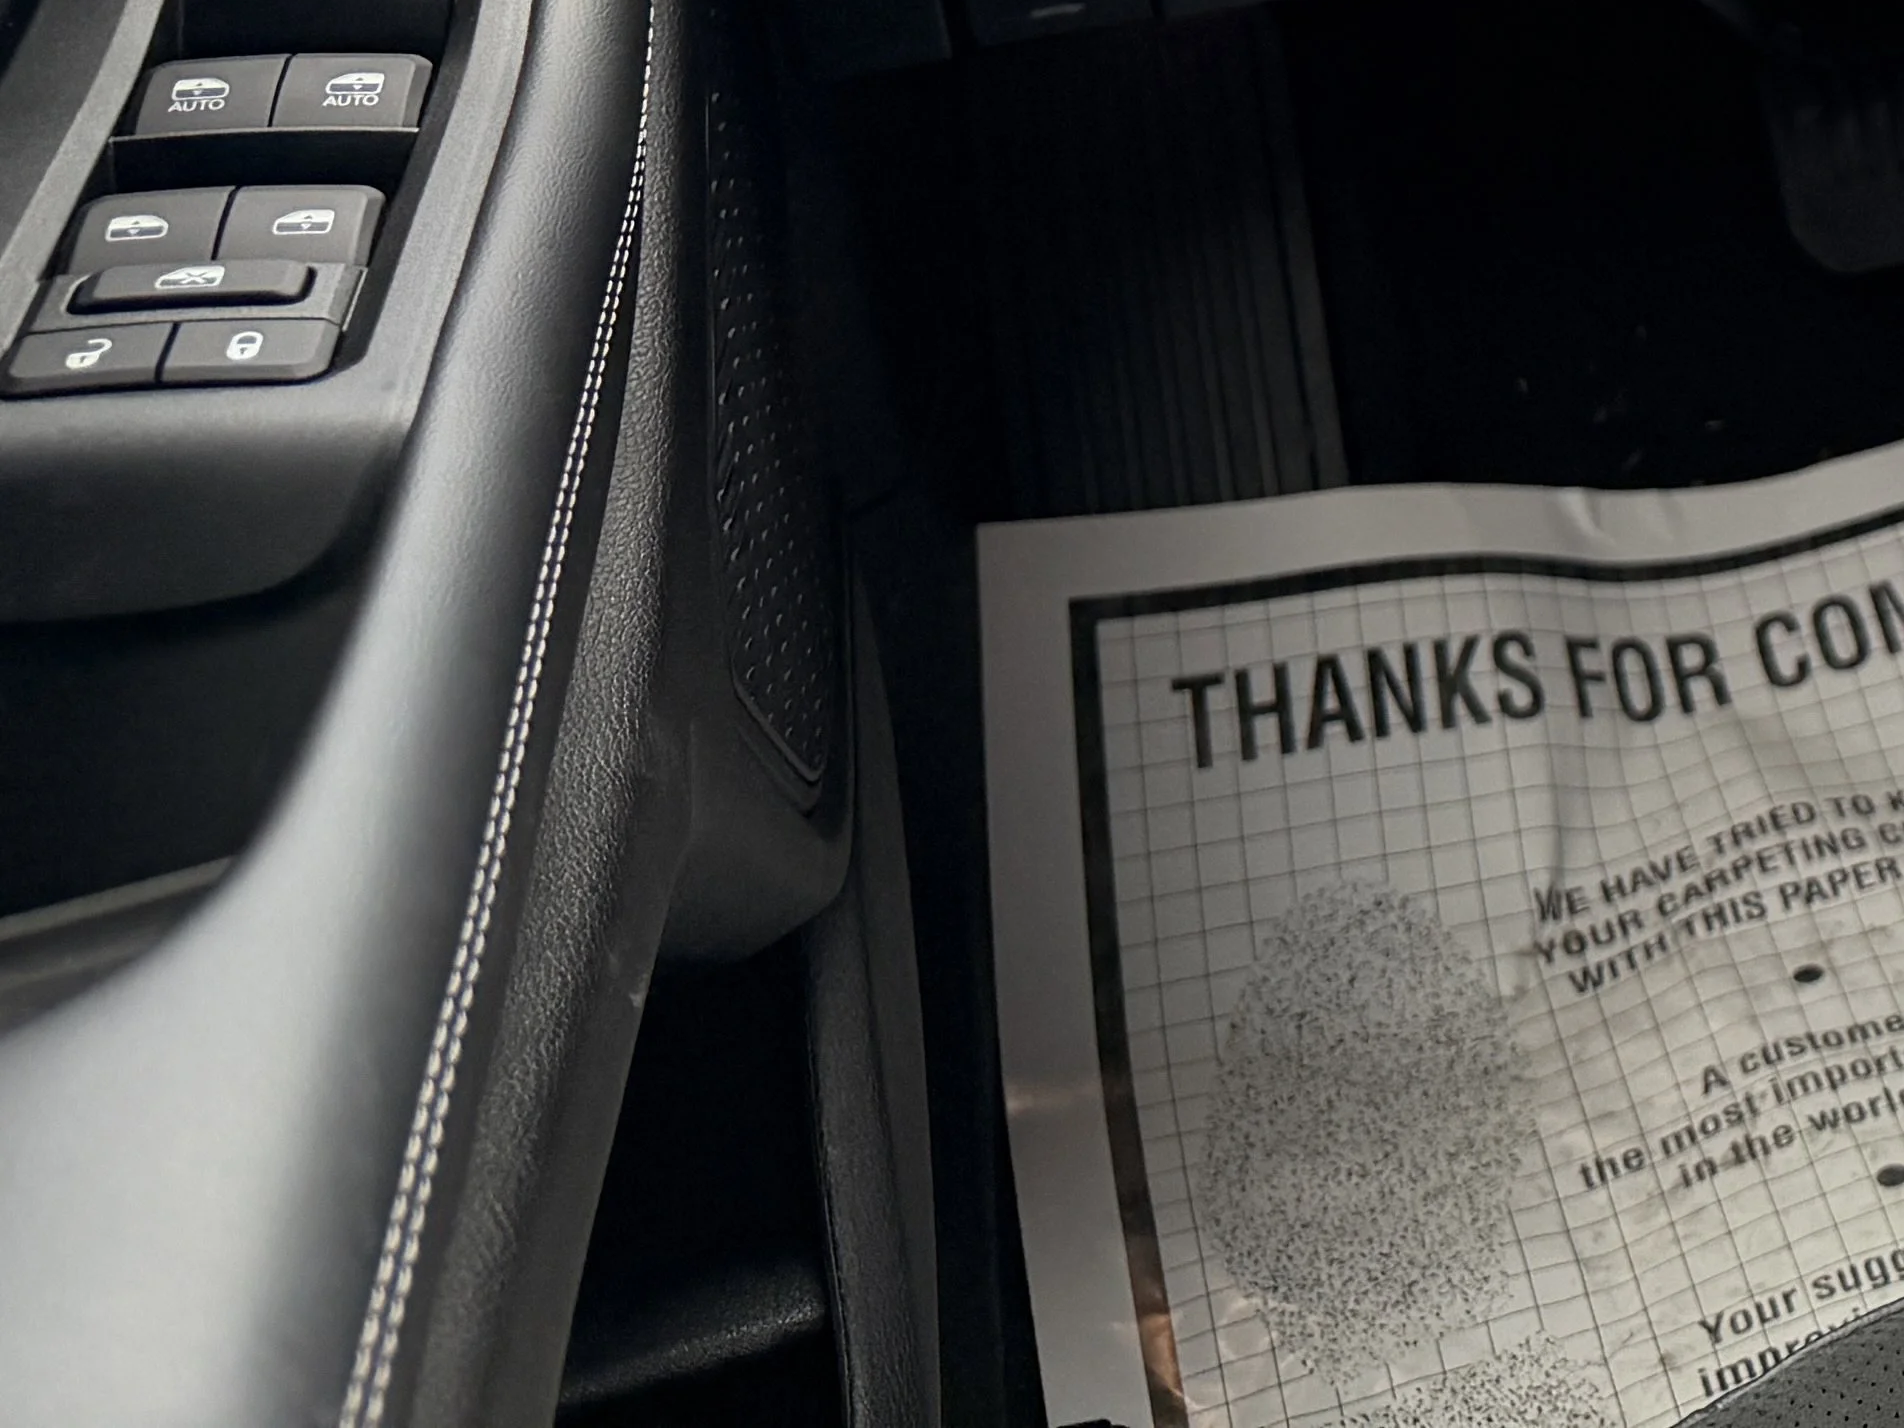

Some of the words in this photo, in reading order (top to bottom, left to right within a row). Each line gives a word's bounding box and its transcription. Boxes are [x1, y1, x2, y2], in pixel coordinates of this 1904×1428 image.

[167, 97, 225, 113] AUTO
[322, 92, 380, 108] AUTO
[1171, 628, 1546, 771] THANKS
[1566, 628, 1734, 728] FOR
[1533, 883, 1590, 923] WE
[1600, 844, 1700, 903] HAVE
[1709, 800, 1817, 857] TRIED
[1826, 793, 1876, 820] TO
[1534, 911, 1645, 965] YOUR
[1657, 826, 1867, 917] CARPETING
[1568, 933, 1668, 995] WITH
[1679, 888, 1769, 938] THIS
[1779, 858, 1902, 912] PAPER
[1700, 1064, 1730, 1095] A
[1578, 1144, 1647, 1192] the
[1660, 1092, 1761, 1157] most
[1678, 1158, 1720, 1189] in
[1728, 1120, 1795, 1171] the
[1698, 1282, 1799, 1347] Your
